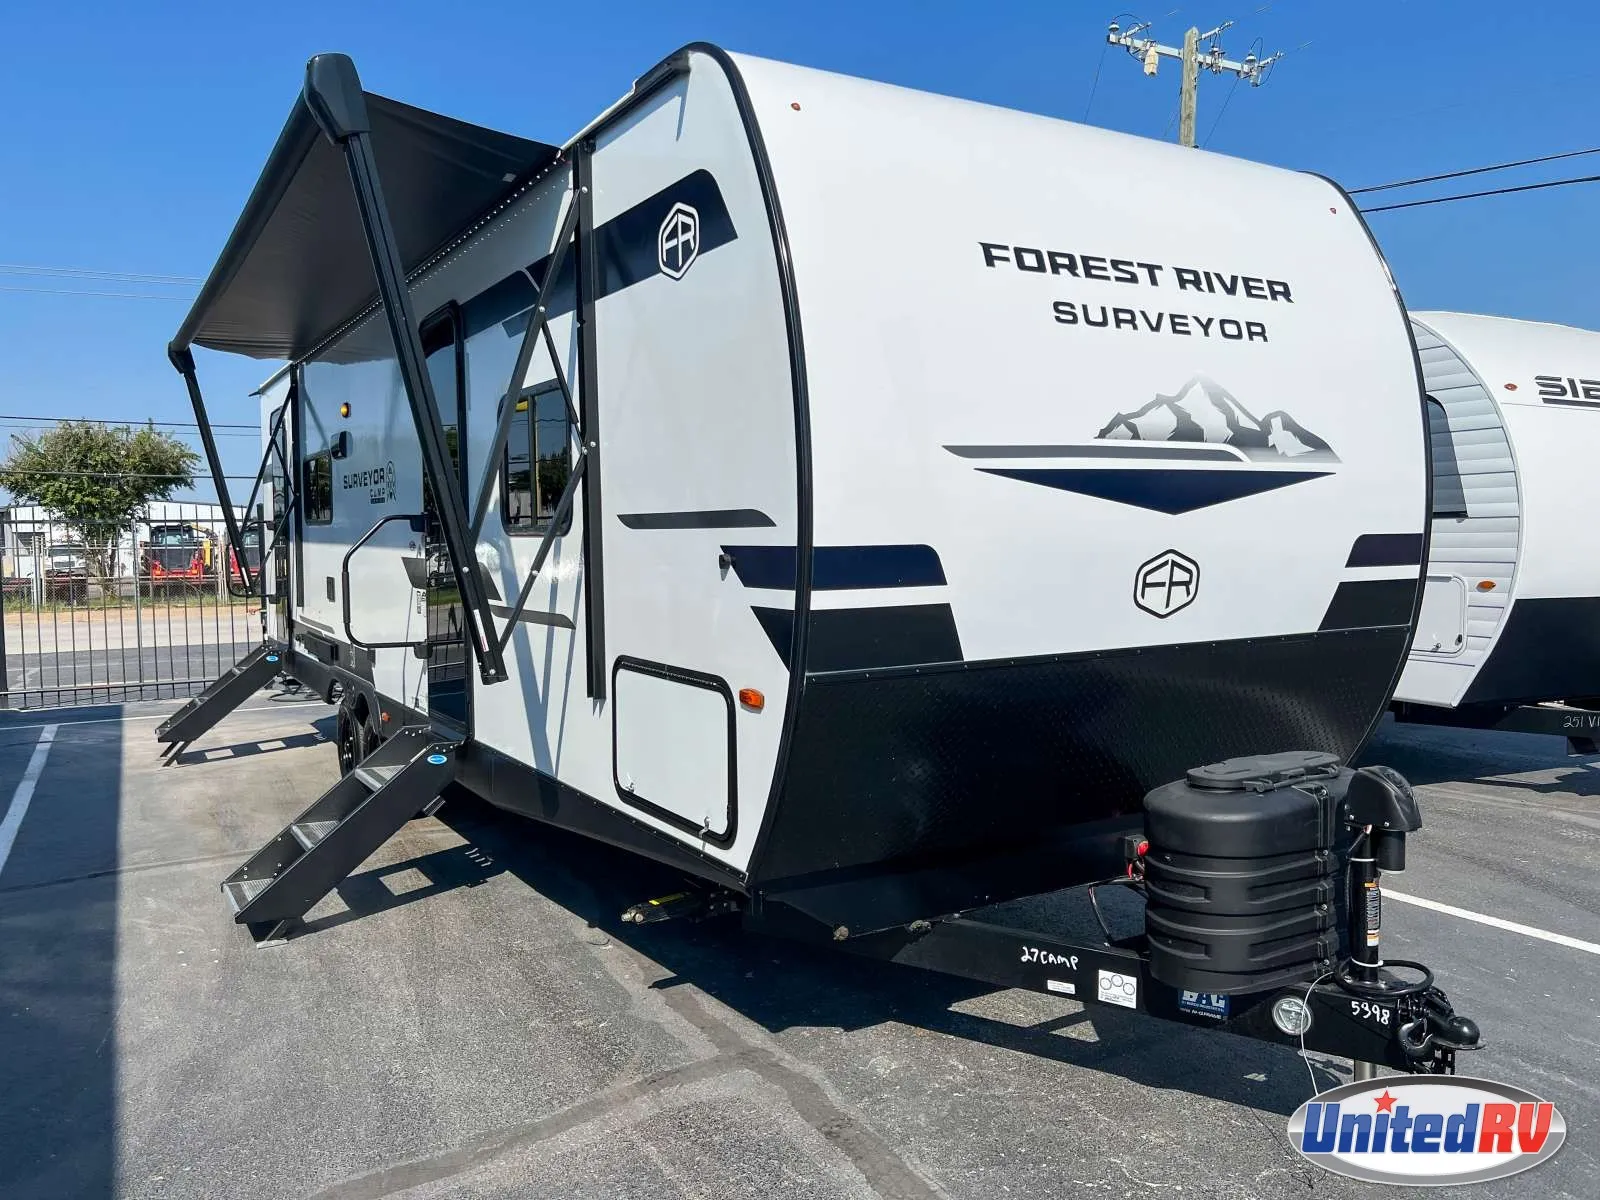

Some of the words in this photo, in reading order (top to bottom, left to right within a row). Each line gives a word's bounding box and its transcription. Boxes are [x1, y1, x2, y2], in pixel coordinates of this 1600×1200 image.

[977, 241, 1164, 287] FOREST
[1171, 266, 1295, 304] RIVER
[1052, 300, 1269, 343] SURVEYOR
[343, 467, 386, 490] SURVEYOR
[1351, 1000, 1391, 1025] 5398
